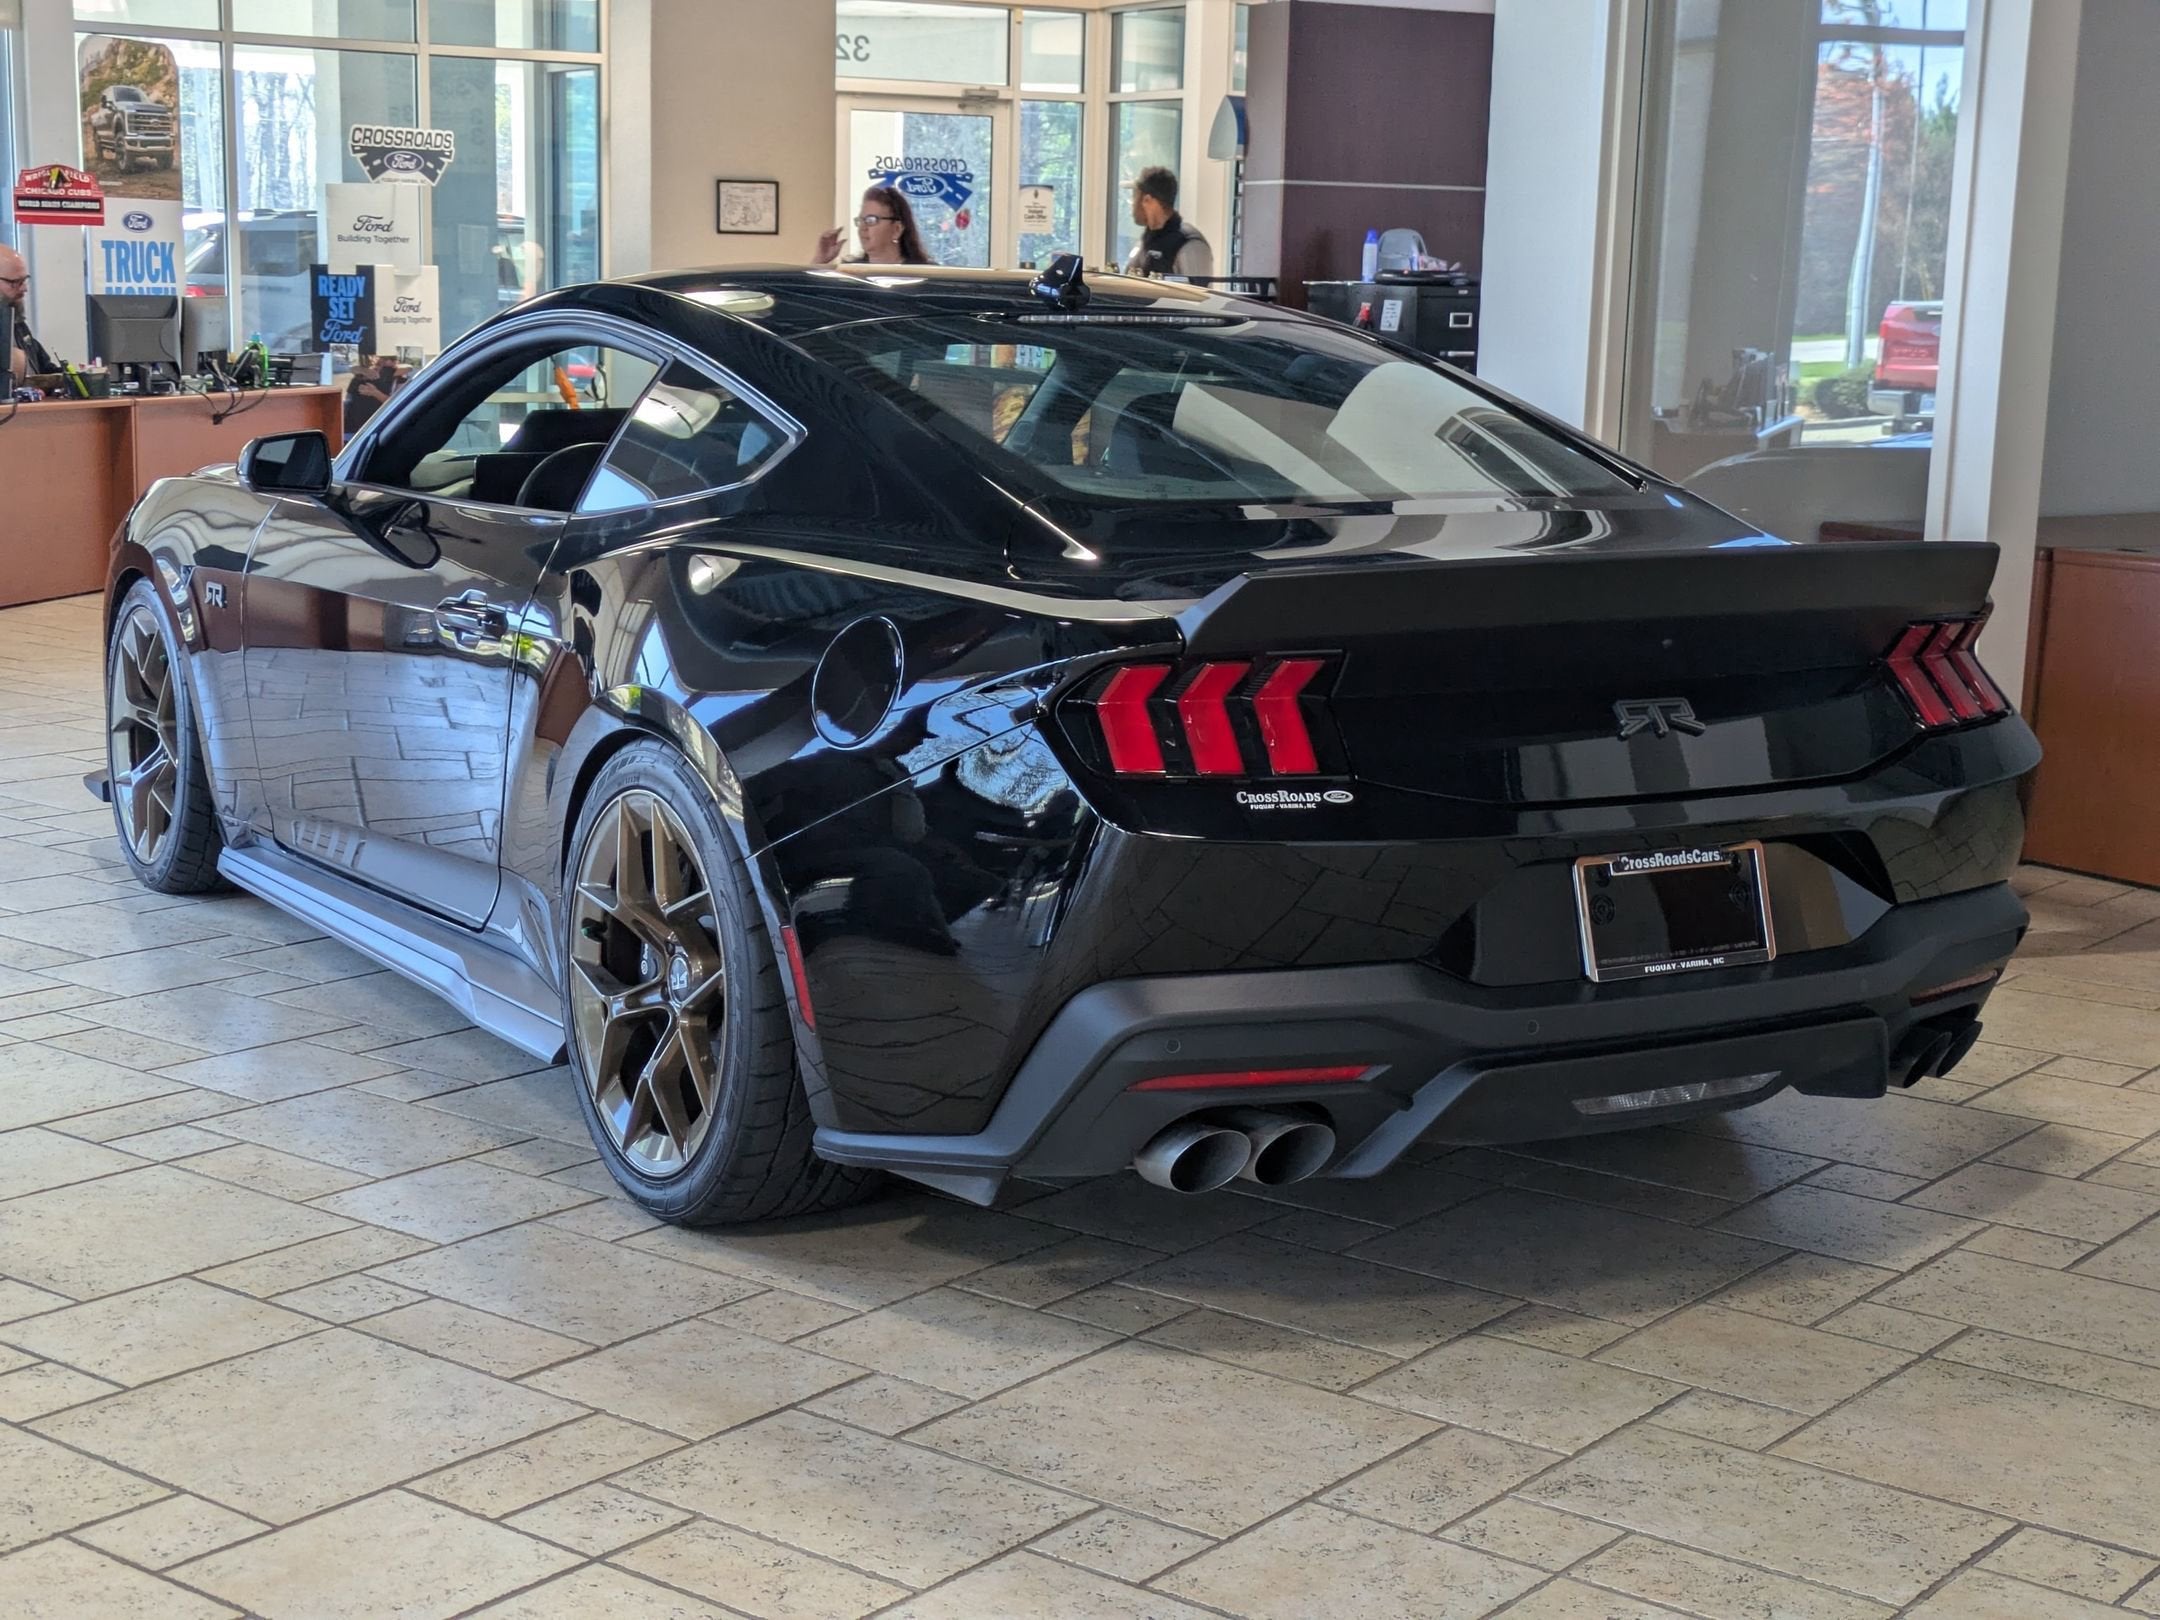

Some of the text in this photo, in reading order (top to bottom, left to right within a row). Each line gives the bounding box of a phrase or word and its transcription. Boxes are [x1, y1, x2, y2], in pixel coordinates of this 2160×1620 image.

[351, 127, 453, 150] CROSSROADS
[391, 153, 417, 170] Ford
[67, 188, 92, 197] CUBS
[127, 214, 149, 229] Ford
[353, 214, 394, 232] Ford
[337, 234, 410, 244] Building Together
[101, 240, 176, 284] TRUCK
[317, 275, 366, 297] READY
[329, 297, 356, 319] SET
[393, 296, 422, 313] Ford
[383, 316, 433, 324] Building Together
[320, 318, 367, 343] Ford
[1713, 957, 1725, 965] NC
